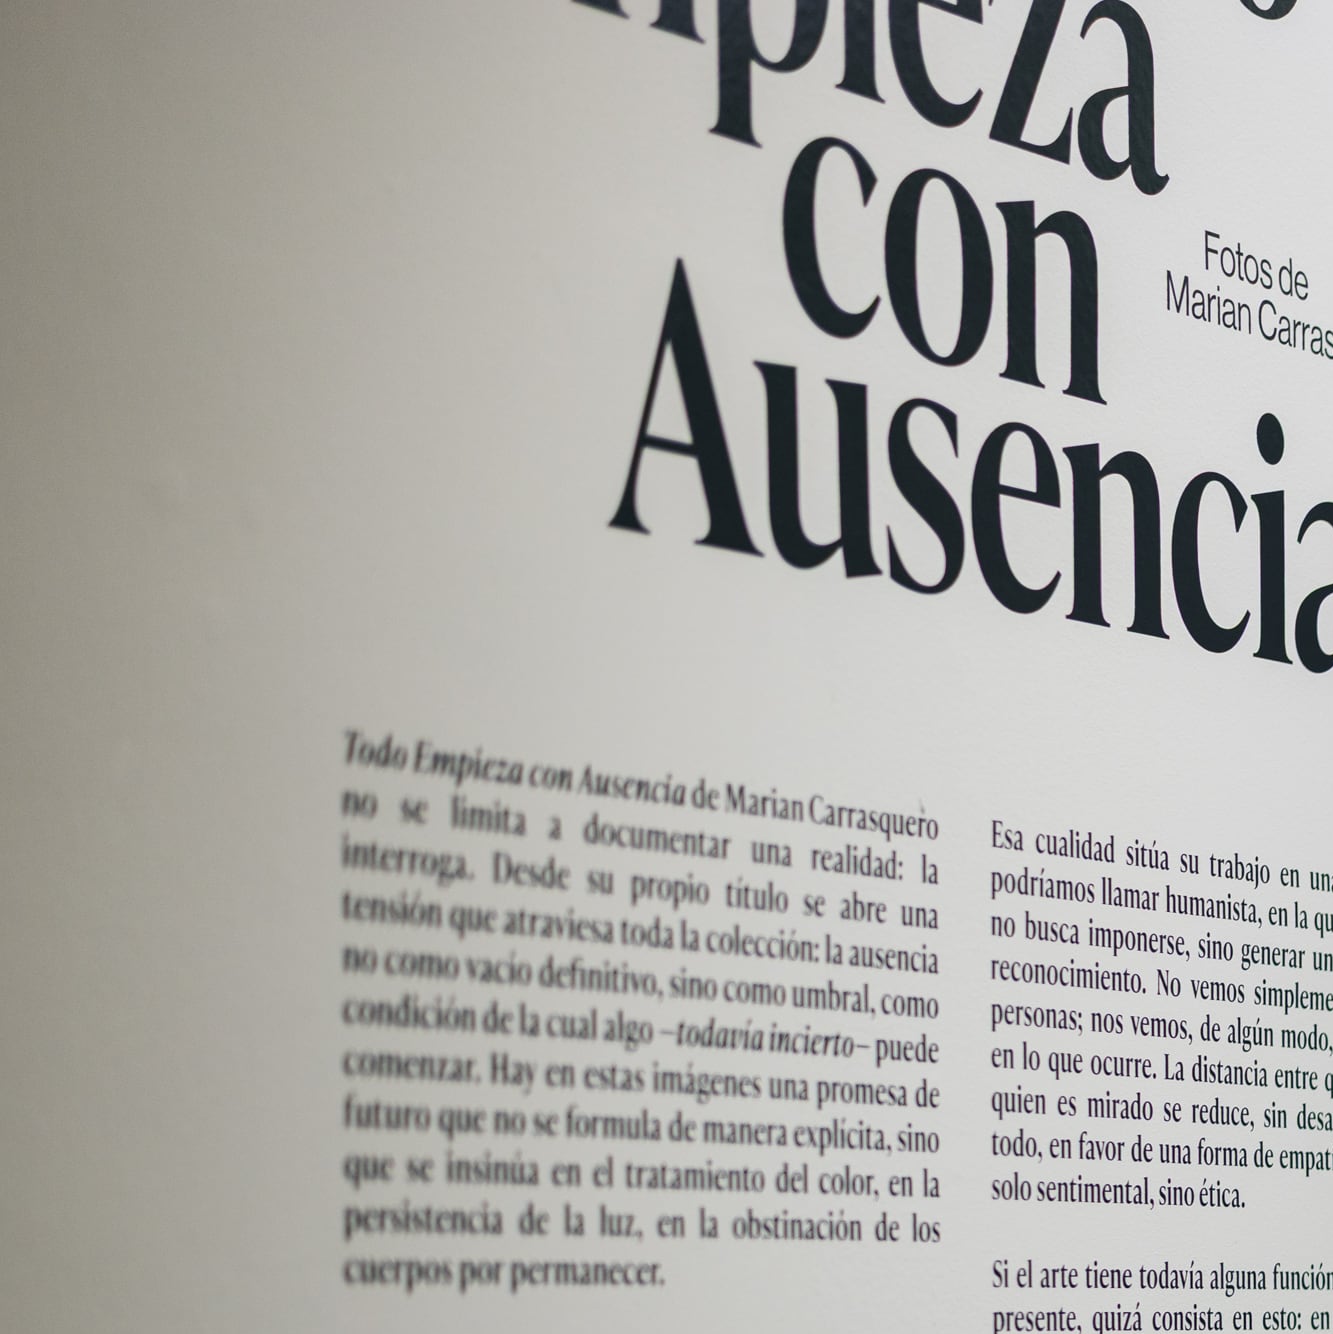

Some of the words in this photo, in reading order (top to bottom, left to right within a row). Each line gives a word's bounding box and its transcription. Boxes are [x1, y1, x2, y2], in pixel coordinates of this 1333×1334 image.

[782, 136, 1108, 405] con
[1204, 229, 1273, 290] Fotos
[1278, 257, 1309, 301] de
[1166, 269, 1252, 335] Marian
[345, 730, 409, 770] Todo
[413, 739, 524, 788] Empieza
[528, 765, 574, 792] con
[579, 765, 687, 807] Ausencia
[690, 778, 720, 811] de
[725, 783, 804, 822] Marian
[808, 794, 939, 843] Carrasquero
[341, 790, 378, 819] no
[400, 798, 428, 825] se
[451, 794, 527, 837] limita
[548, 817, 562, 841] a
[582, 812, 731, 860] documentar
[751, 841, 792, 868] una
[811, 843, 904, 881] realidad:
[921, 853, 939, 886] la
[991, 819, 1024, 852] Esa
[1035, 829, 1116, 864] cualidad
[1125, 838, 1170, 871] sitúa
[1179, 853, 1200, 875] su
[1209, 852, 1271, 890] trabajo
[1279, 867, 1300, 889] en
[991, 866, 1096, 904] podríamos
[1101, 876, 1160, 912] llamar
[1165, 884, 1263, 929] humanista,
[1268, 906, 1289, 928] en
[1294, 900, 1309, 930] la
[991, 958, 1147, 995] reconocimiento.
[1156, 968, 1182, 998] No
[1190, 979, 1245, 1004] vemos
[991, 1003, 1083, 1033] personas;
[1090, 1012, 1124, 1035] nos
[1129, 1015, 1193, 1046] vemos,
[1199, 1013, 1221, 1043] de
[1227, 1016, 1274, 1053] algún
[1280, 1023, 1333, 1056] modo,
[991, 1084, 1046, 1121] quien
[1057, 1095, 1077, 1117] es
[1087, 1090, 1154, 1121] mirado
[1163, 1101, 1182, 1123] se
[1191, 1096, 1255, 1132] reduce,
[1263, 1101, 1288, 1129] sin
[991, 1171, 1032, 1201] solo
[1036, 1174, 1155, 1211] sentimental,
[1158, 1177, 1195, 1207] sino
[1198, 1177, 1246, 1209] ética.
[992, 1259, 1009, 1289] Si
[1016, 1259, 1033, 1289] el
[1040, 1265, 1079, 1289] arte
[1084, 1260, 1133, 1289] tiene
[1138, 1259, 1205, 1290] todavía
[1209, 1261, 1267, 1298] alguna
